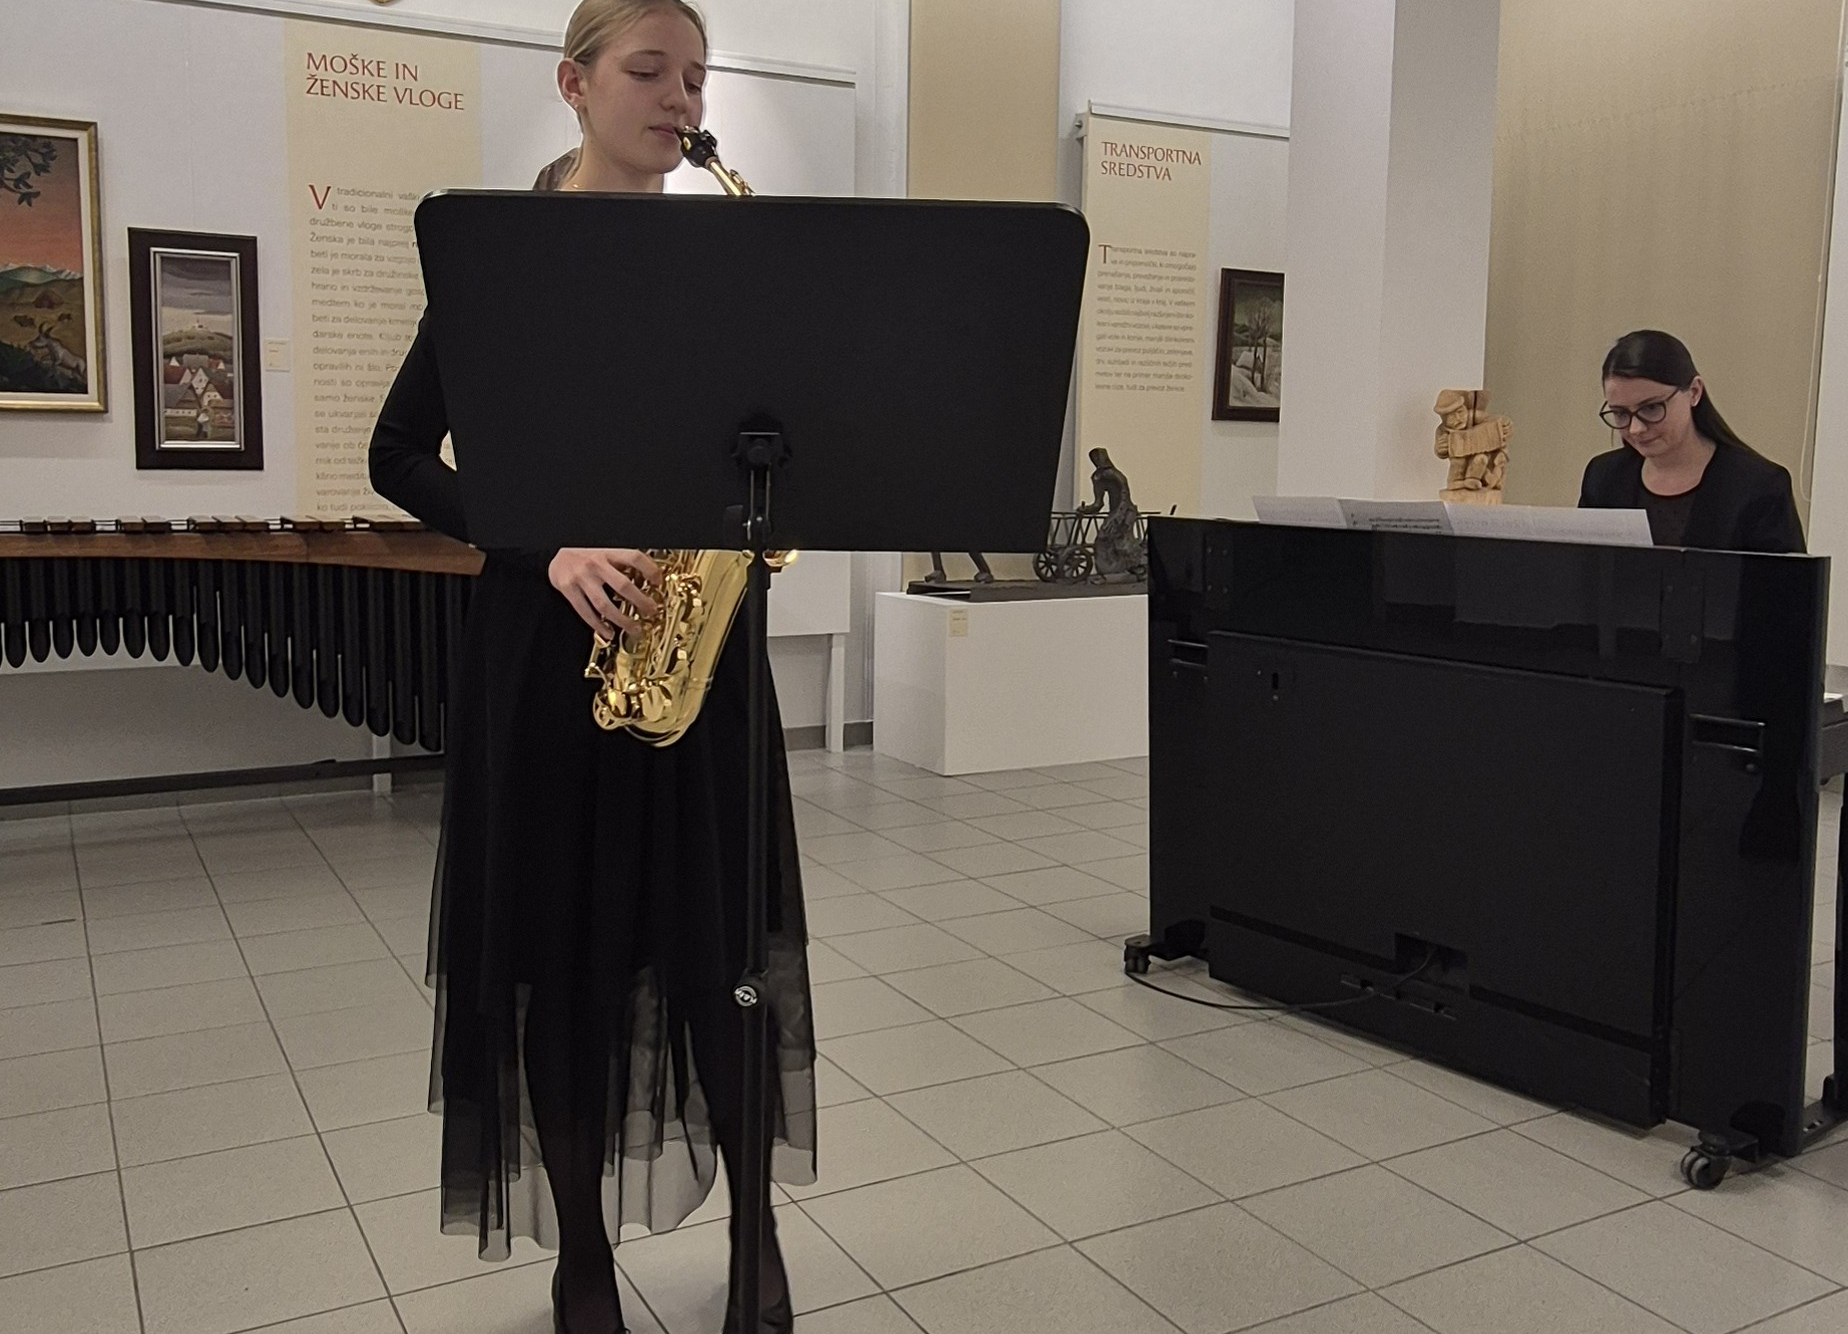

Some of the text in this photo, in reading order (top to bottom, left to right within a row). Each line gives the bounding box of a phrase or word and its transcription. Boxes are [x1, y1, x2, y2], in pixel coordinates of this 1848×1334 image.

[306, 52, 419, 82] MOŠKE IN
[305, 73, 465, 111] ŽENSKE VLOGE
[1101, 141, 1202, 166] TRANSPORTNA
[1101, 160, 1172, 182] SREDSTVA
[308, 184, 331, 210] V
